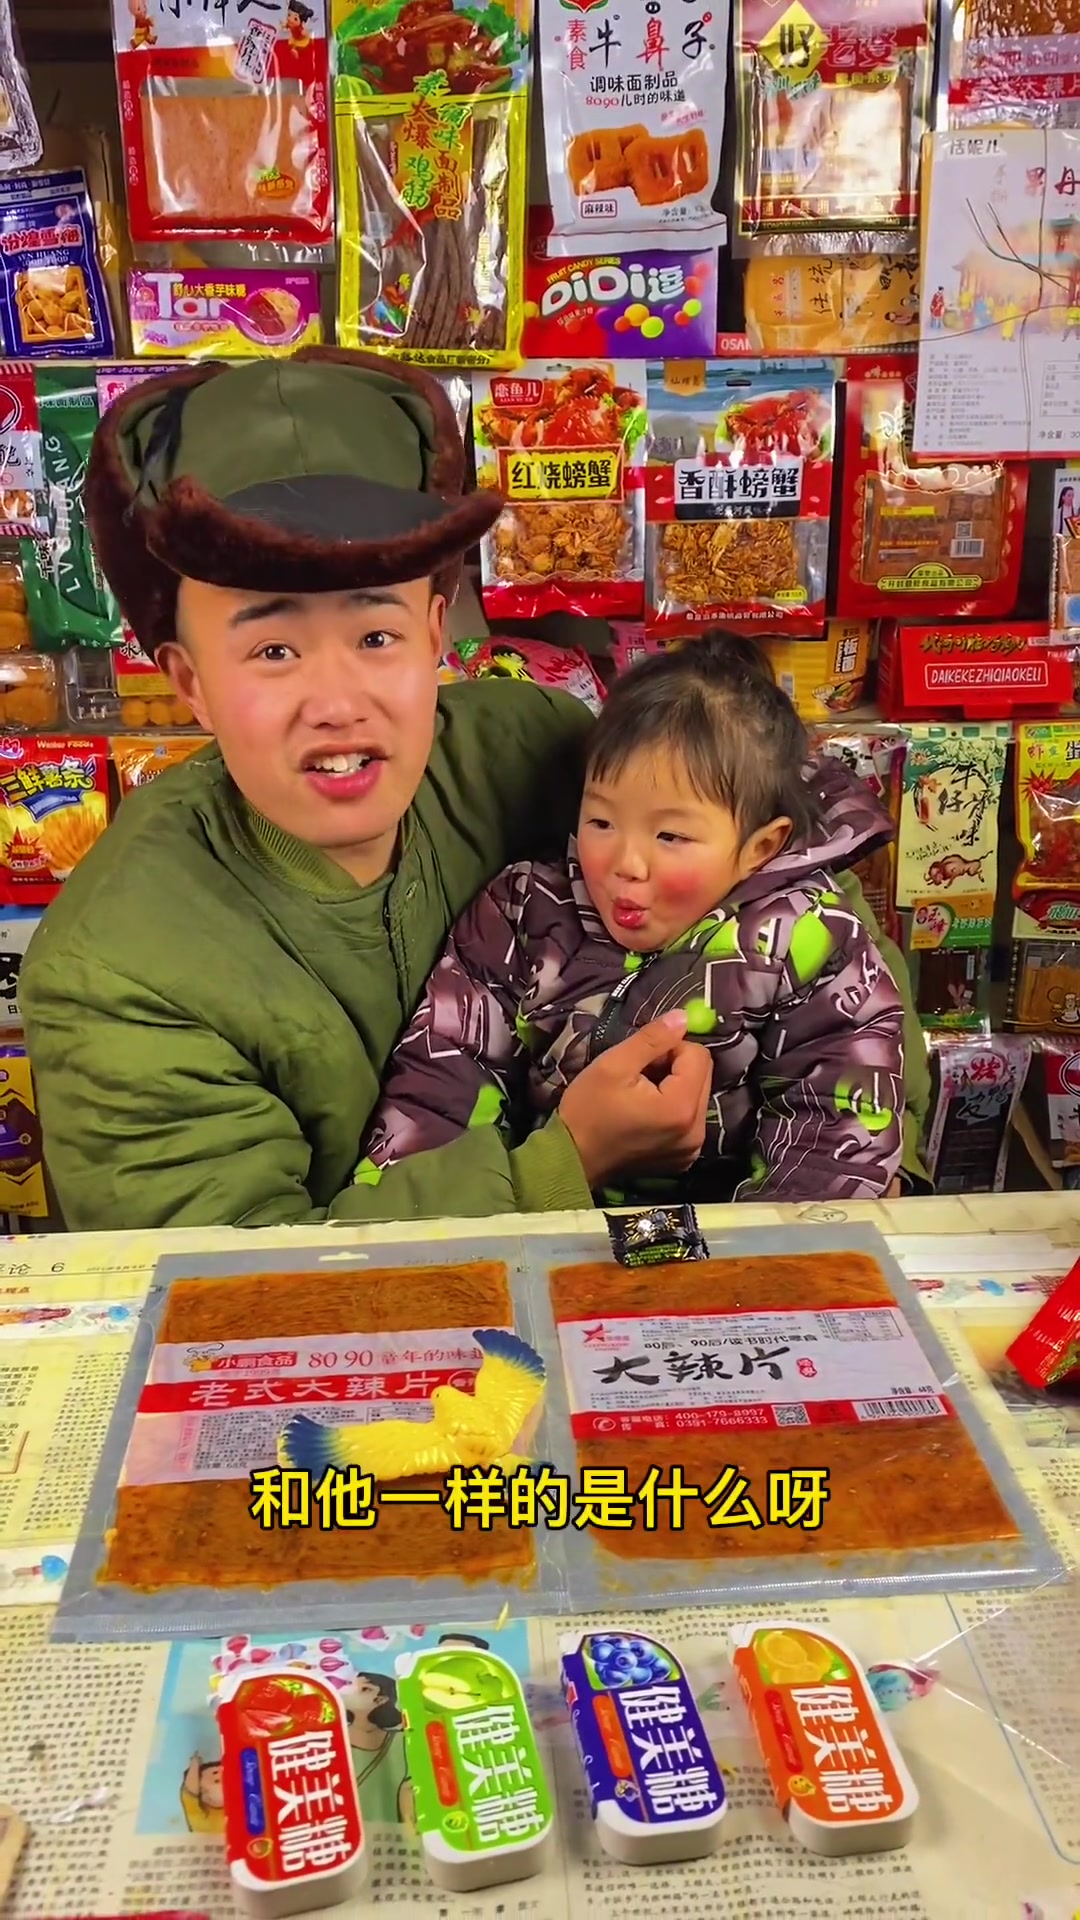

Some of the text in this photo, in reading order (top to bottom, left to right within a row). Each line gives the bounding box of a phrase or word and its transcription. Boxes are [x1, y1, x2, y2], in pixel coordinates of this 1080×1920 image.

[590, 70, 679, 93] 调味面制品
[511, 459, 613, 490] 红烧螃蟹
[931, 666, 1042, 684] DAIKEKEZHIQIAOKELI
[51, 1262, 65, 1273] 6
[308, 1351, 338, 1369] 80
[344, 1349, 374, 1368] 90
[592, 1346, 791, 1386] 大辣片
[188, 1370, 440, 1407] 老式大辣片
[618, 1686, 718, 1815] 健美糖
[790, 1685, 894, 1814] 健美糖
[452, 1704, 545, 1843] 健美糖
[268, 1731, 351, 1873] 健美糖
